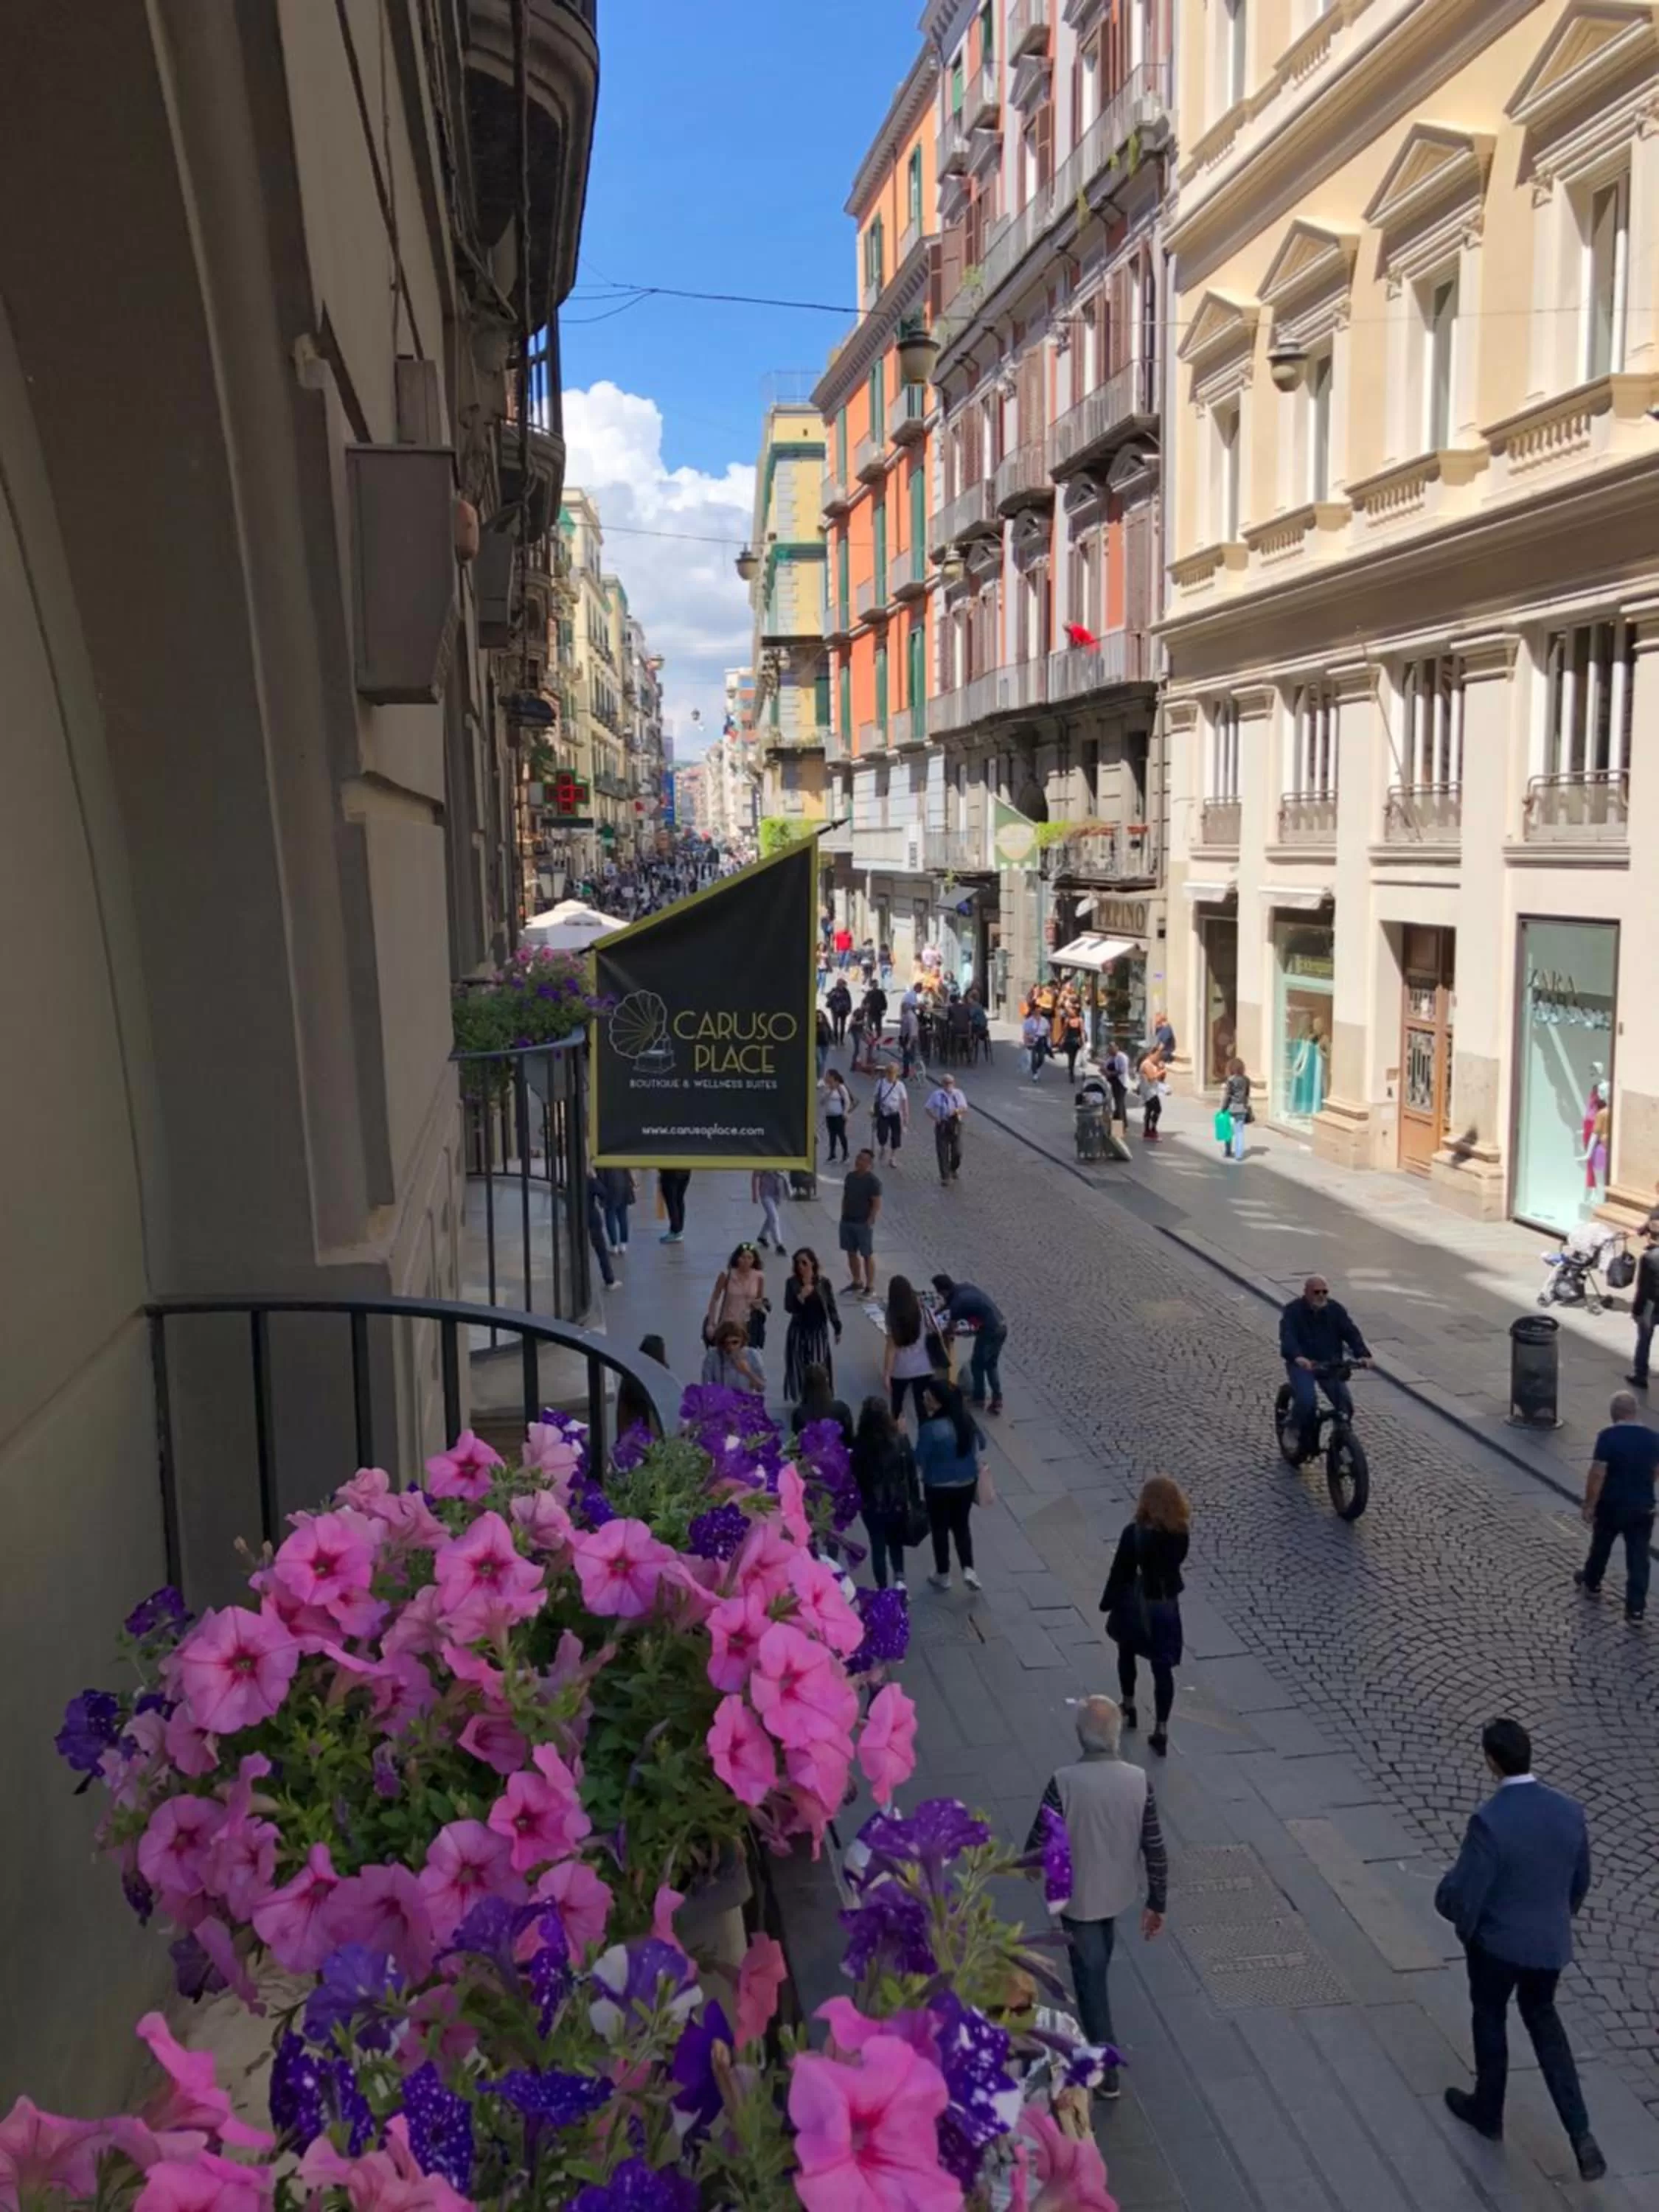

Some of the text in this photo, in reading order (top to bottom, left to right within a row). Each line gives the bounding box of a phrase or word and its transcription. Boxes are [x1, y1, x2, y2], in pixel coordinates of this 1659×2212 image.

[1527, 968, 1578, 994] ZARA
[673, 1011, 797, 1041] CARUSO
[695, 1044, 776, 1074] PLACE
[630, 1079, 778, 1090] BOUTIQUE & WELLNESS SUITES
[641, 1123, 765, 1138] www.carusoplace.com
